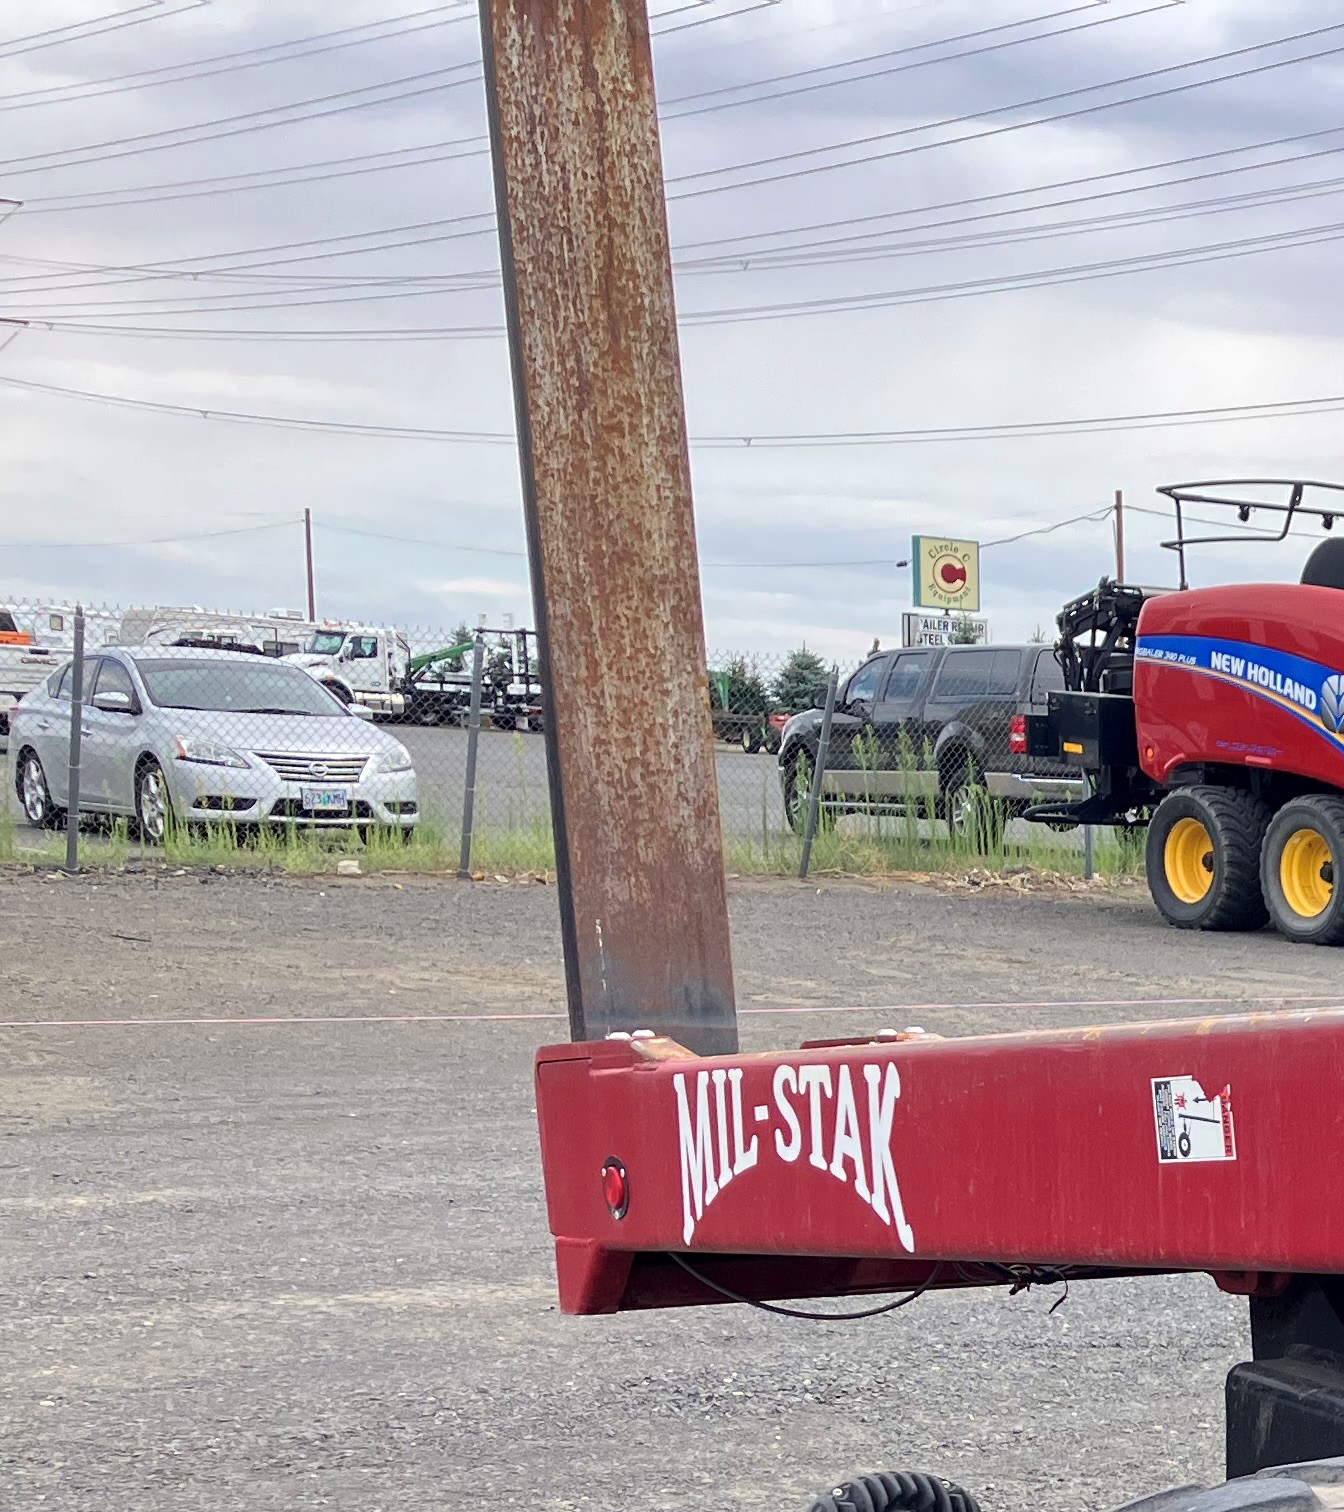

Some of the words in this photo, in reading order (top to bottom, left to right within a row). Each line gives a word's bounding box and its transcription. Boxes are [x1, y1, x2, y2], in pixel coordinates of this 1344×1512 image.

[928, 542, 959, 559] Circle
[928, 583, 971, 604] Equipment
[921, 619, 949, 632] AILER
[1211, 651, 1246, 678] NEW
[1247, 661, 1317, 710] HOLLAND
[673, 1061, 915, 1253] MIL-STAK
